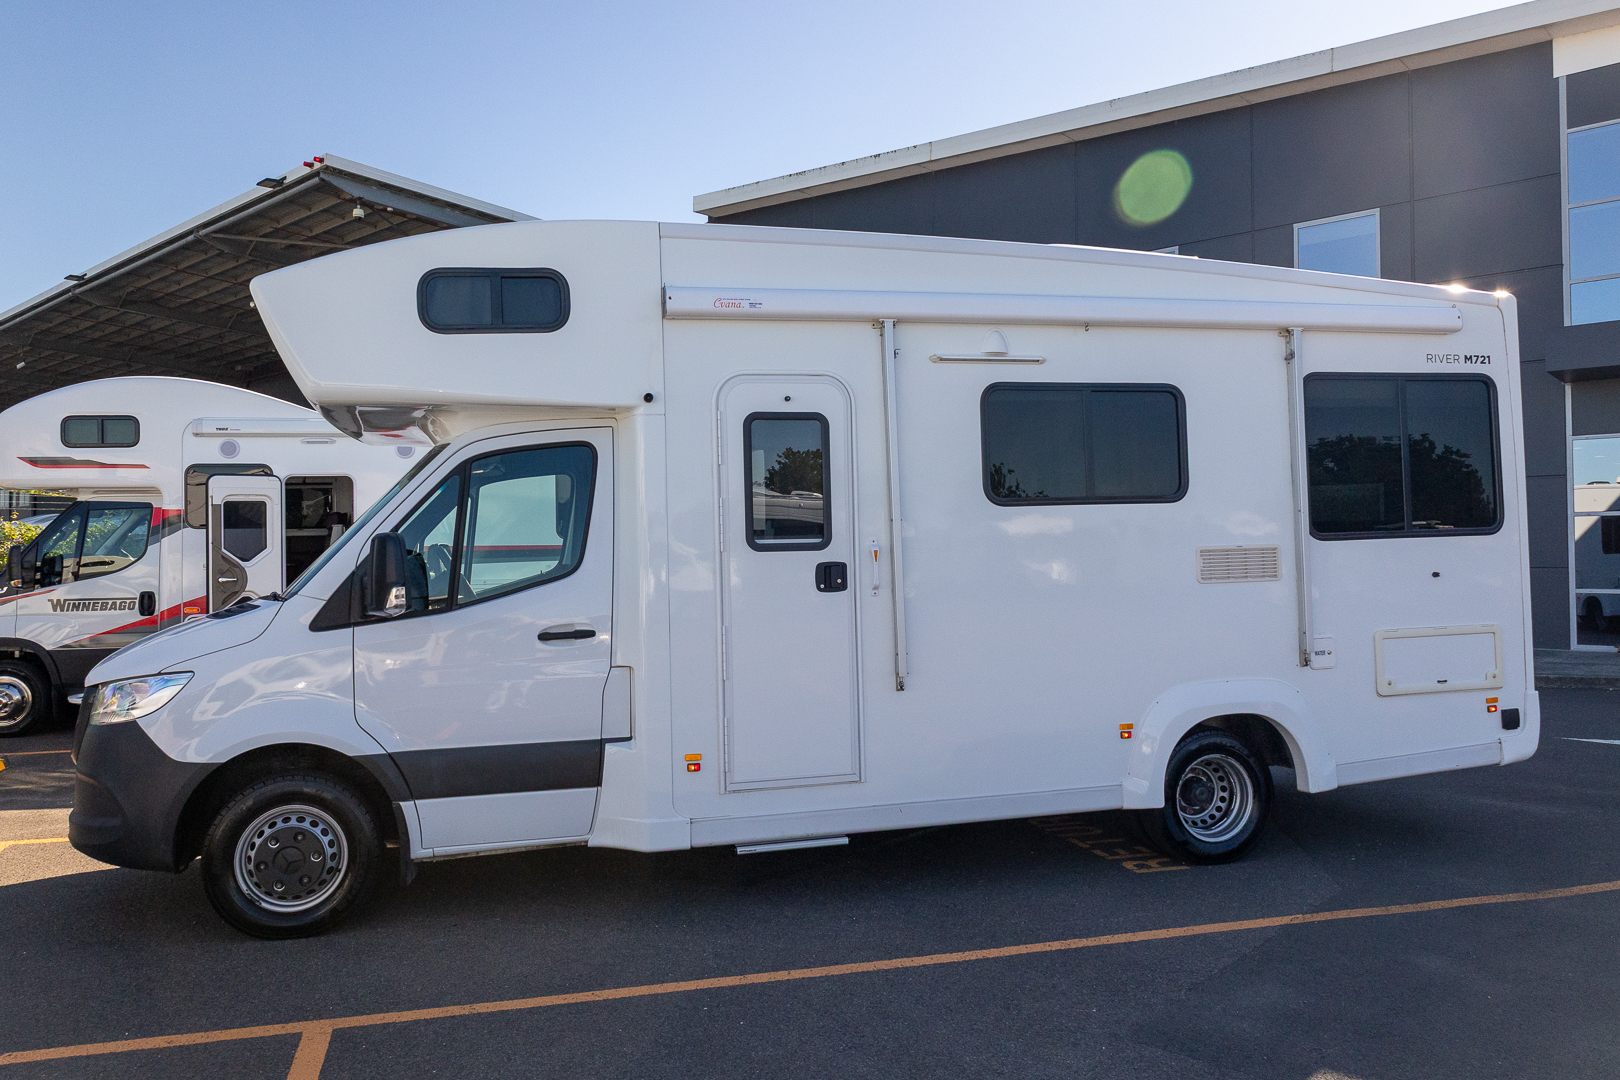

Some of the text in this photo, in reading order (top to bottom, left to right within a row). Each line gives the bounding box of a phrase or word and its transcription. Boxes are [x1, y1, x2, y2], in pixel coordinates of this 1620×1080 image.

[1426, 353, 1491, 365] RIVER M721
[47, 597, 138, 612] WINNEBAGO
